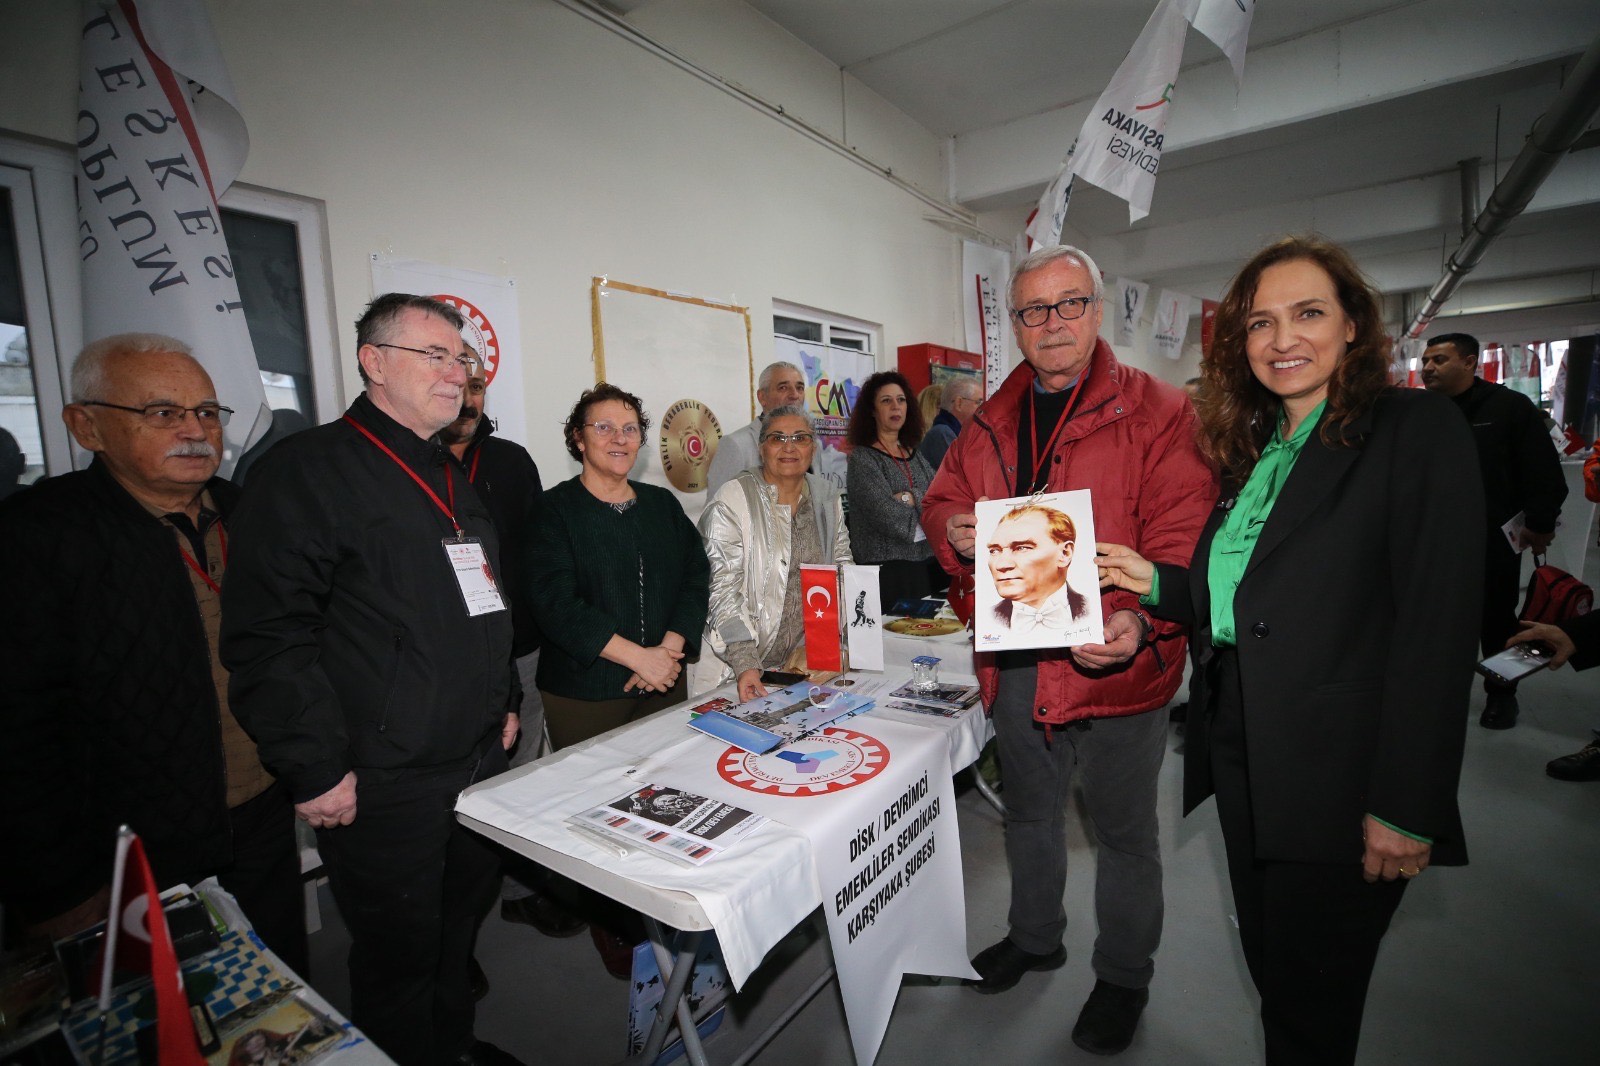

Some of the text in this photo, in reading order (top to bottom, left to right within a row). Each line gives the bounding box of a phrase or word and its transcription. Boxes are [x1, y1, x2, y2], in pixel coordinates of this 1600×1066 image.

[835, 796, 940, 917] EMEKLİLER SENDİKASI
[849, 770, 929, 863] DİSK / DEVRİMCİ
[847, 831, 936, 944] KARŞIYAKA ŞUBESİ
